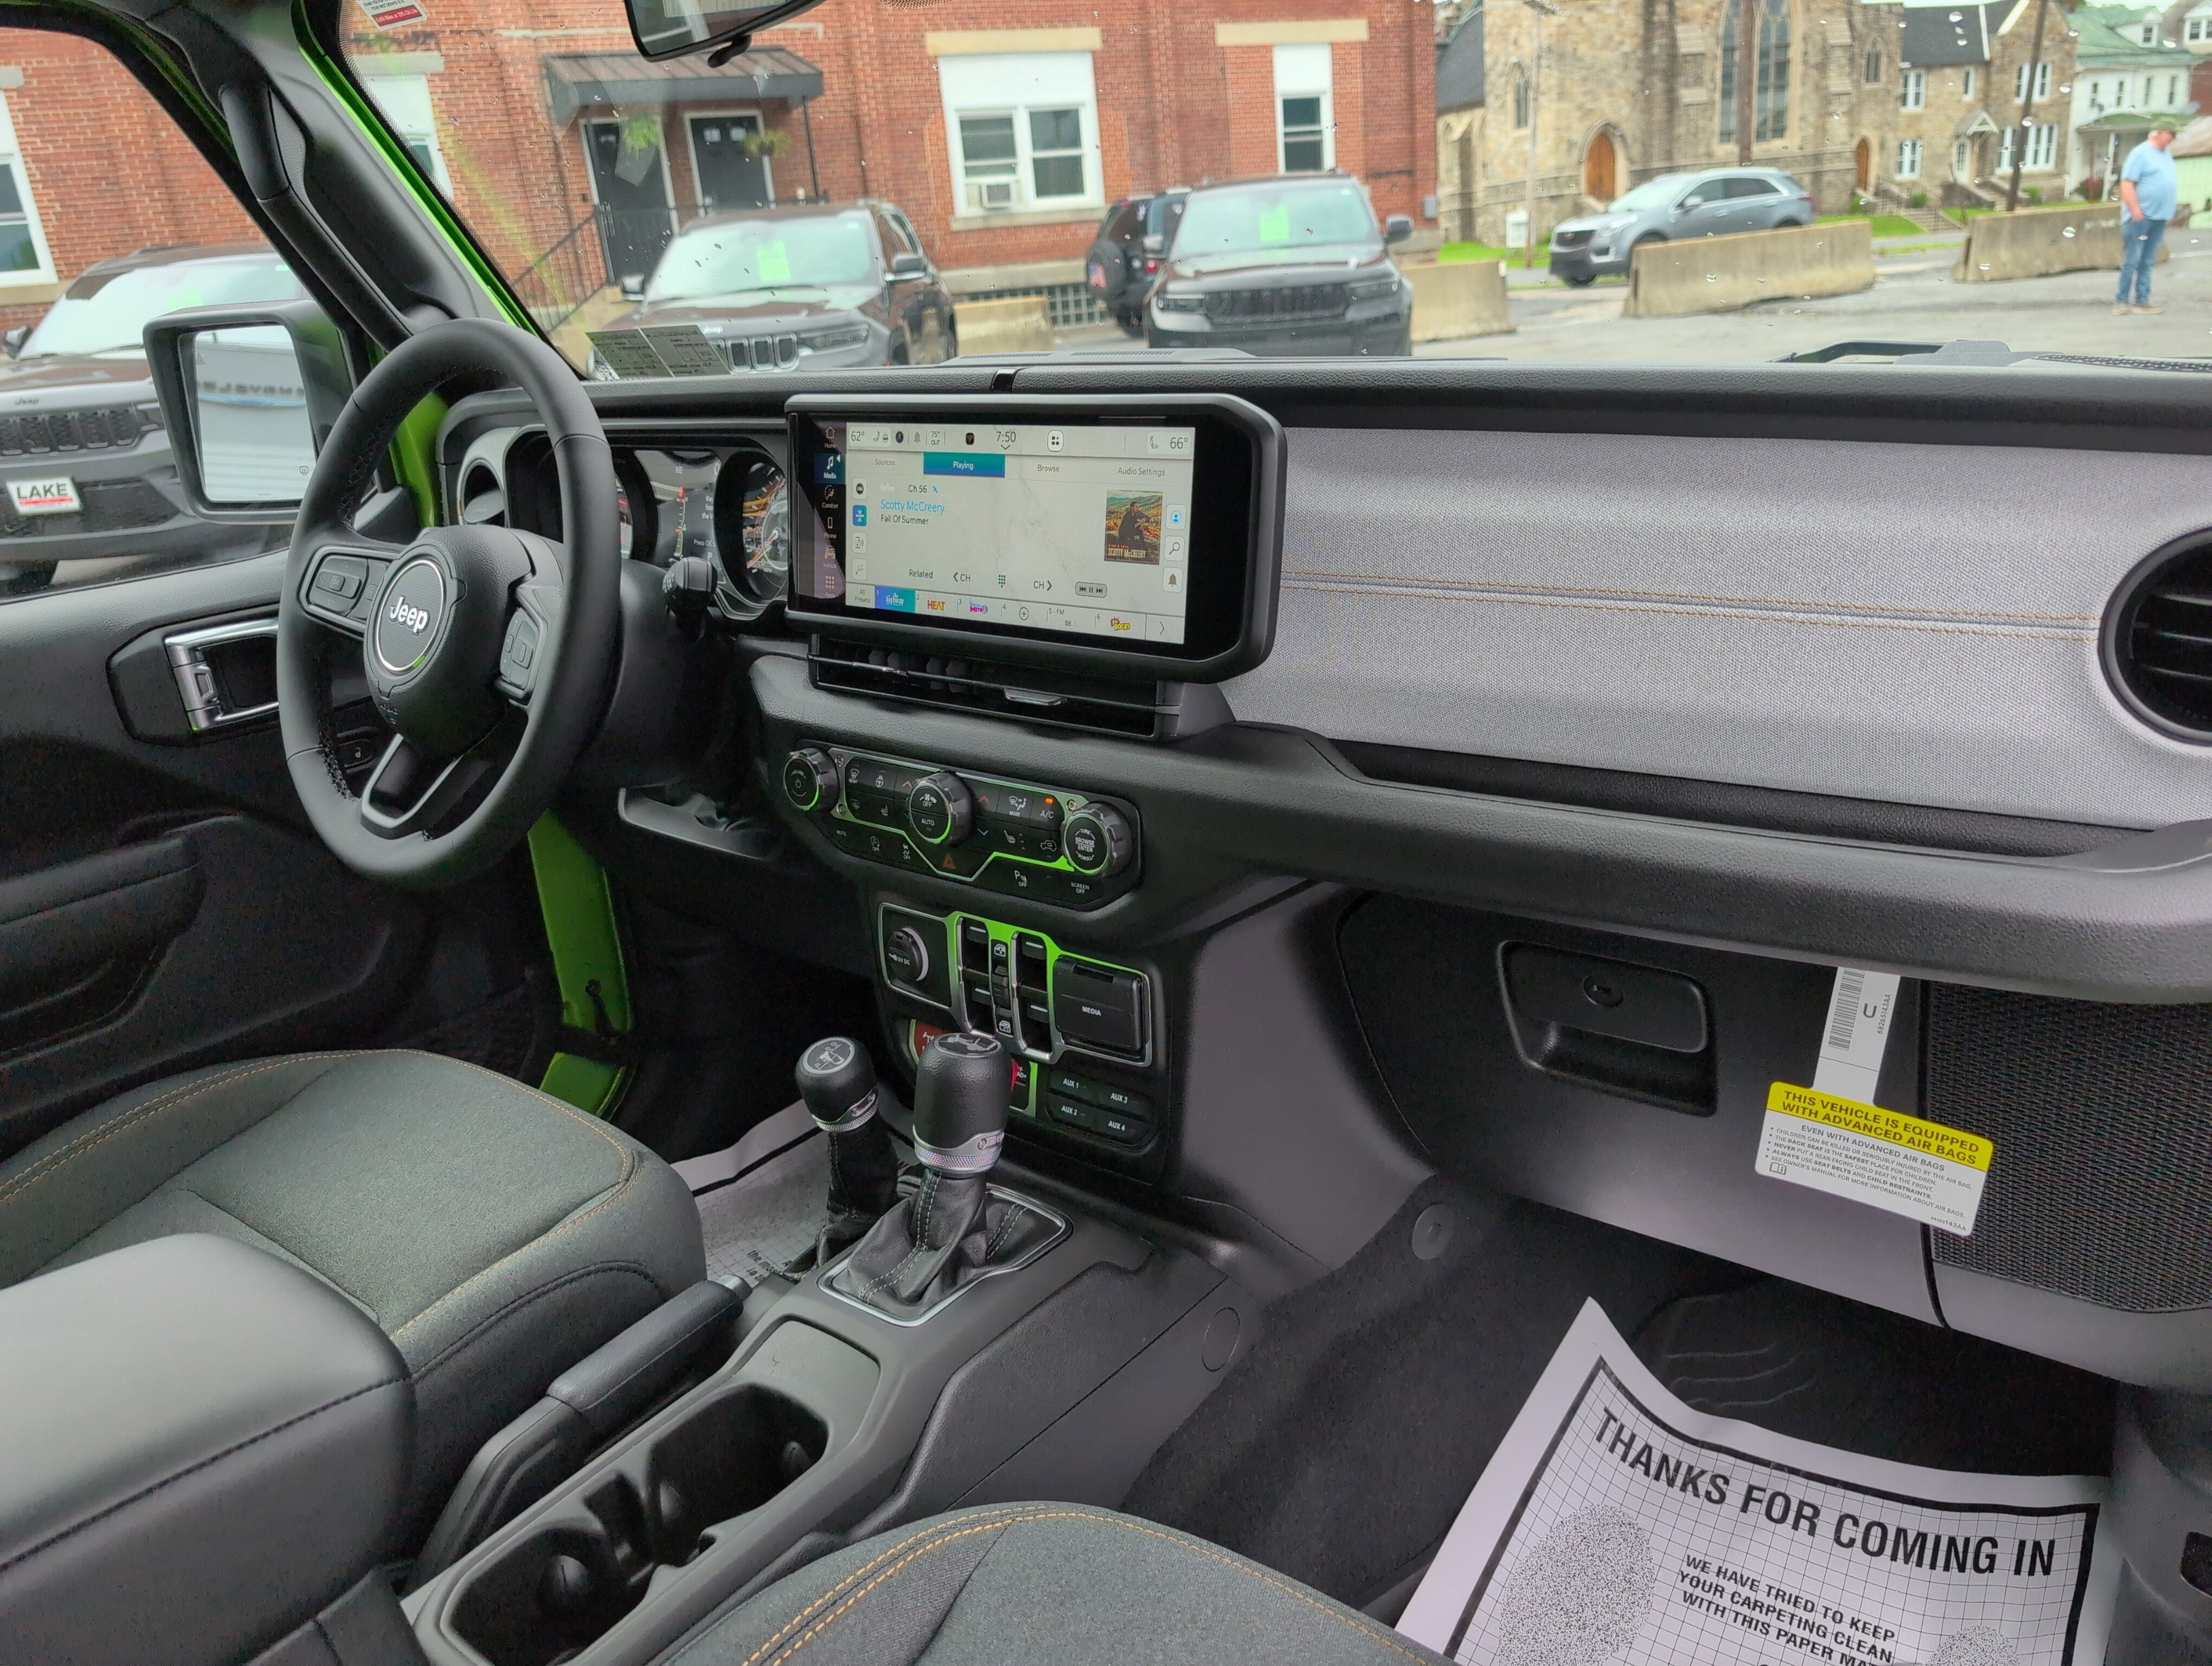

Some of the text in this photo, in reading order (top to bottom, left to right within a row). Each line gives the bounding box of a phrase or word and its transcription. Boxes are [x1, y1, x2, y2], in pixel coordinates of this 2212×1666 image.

[996, 431, 1016, 443] 7:50
[676, 466, 684, 475] NE
[953, 461, 974, 471] Playing
[1038, 464, 1060, 472] Browse
[1118, 467, 1165, 477] Audio Settings
[908, 484, 927, 493] Ch 56
[881, 499, 945, 515] Scotty McCreery
[881, 514, 929, 525] Fall Of Summer
[707, 552, 712, 561] P
[1108, 548, 1124, 557] SCOTTY
[909, 569, 933, 579] Related
[960, 574, 970, 582] CH
[1033, 580, 1044, 589] CH
[927, 600, 946, 611] HEAT
[389, 596, 429, 633] Jeep
[1040, 810, 1054, 818] A/C
[1075, 836, 1095, 845] BROWSE
[1071, 882, 1090, 890] SCREEN
[1082, 1005, 1102, 1017] MEDIA
[1863, 1003, 1877, 1018] U
[1877, 994, 1892, 1035] 68265143AA
[1063, 1078, 1075, 1087] AUX
[1110, 1092, 1123, 1102] AUX
[1062, 1105, 1073, 1114] AUX
[1108, 1120, 1126, 1132] AUX 4
[1784, 1091, 1979, 1152] THIS VEHICLE IS EQUIPPED
[1782, 1101, 1977, 1164] WITH ADVANCED AIR BAGS
[1801, 1125, 1945, 1171] EVEN WITH ADVANCED AIR BAGS
[1777, 1128, 1806, 1139] CHILDREN
[1830, 1143, 1850, 1152] KILLED
[1862, 1151, 1895, 1165] SERIOUSLY
[1896, 1161, 1921, 1173] INJURED
[1933, 1172, 1944, 1181] THE
[1958, 1181, 1972, 1190] BAG.
[1787, 1139, 1805, 1147] BACK
[1807, 1144, 1823, 1152] SEAT
[1844, 1154, 1869, 1164] SAFEST
[1870, 1161, 1889, 1170] PLACE
[1905, 1171, 1937, 1186] CHILDREN.
[1774, 1142, 1796, 1151] NEVER
[1816, 1154, 1853, 1168] REAR-FACING
[1855, 1164, 1874, 1174] CHILD
[1875, 1170, 1889, 1178] SEAT
[1898, 1177, 1911, 1185] THE
[1912, 1181, 1933, 1193] FRONT.
[1772, 1149, 1799, 1160] ALWAYS
[1814, 1160, 1830, 1168] SEAT
[1831, 1165, 1851, 1174] BELTS
[1867, 1175, 1888, 1185] CHILD
[1889, 1182, 1932, 1200] RESTRAINTS.
[1783, 1159, 1810, 1170] OWNER'S
[1811, 1167, 1836, 1178] MANUAL
[1851, 1178, 1869, 1187] MORE
[1870, 1183, 1912, 1201] INFORMATION
[1913, 1196, 1934, 1208] ABOUT
[1934, 1203, 1946, 1212] AIR
[1947, 1208, 1965, 1219] BAGS.
[1595, 1406, 2055, 1577] THANKS FOR COMING IN
[1686, 1554, 1895, 1643] WE HAVE TRIED TO KEEP
[1679, 1570, 1726, 1599] YOUR
[1731, 1591, 1828, 1639] CARPETING
[1834, 1631, 1892, 1664] CLEAN
[1682, 1590, 1727, 1619] WITH
[1732, 1609, 1771, 1636] THIS
[1776, 1629, 1834, 1661] PAPER
